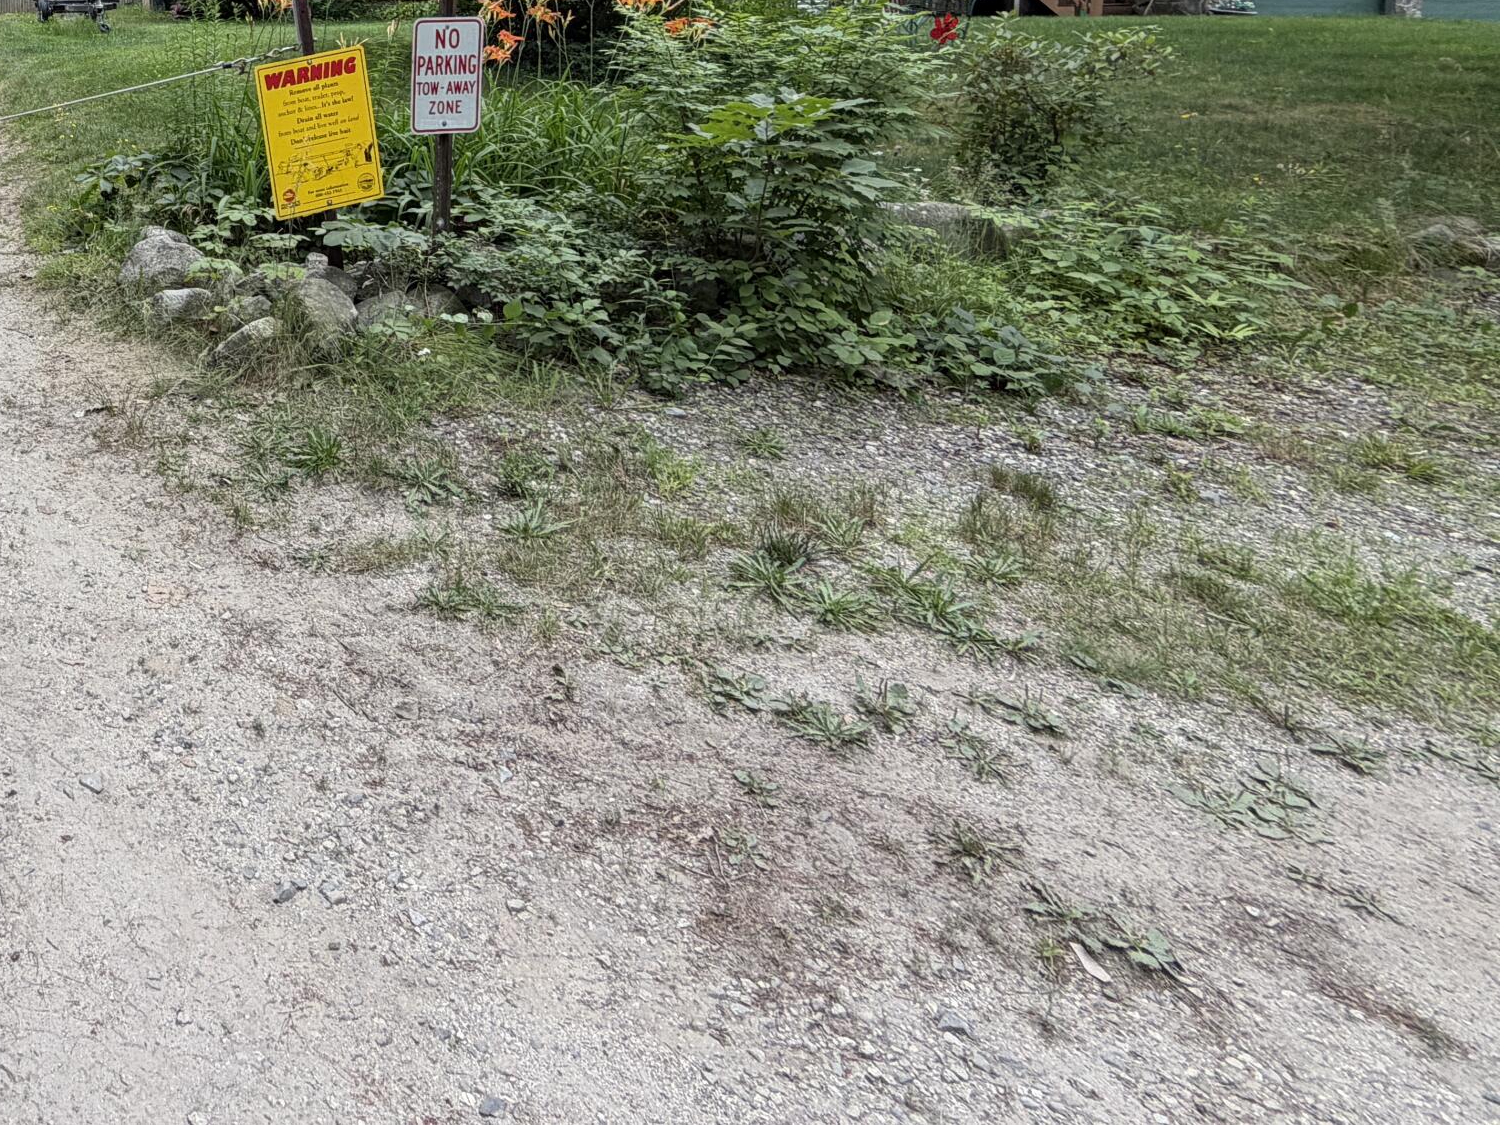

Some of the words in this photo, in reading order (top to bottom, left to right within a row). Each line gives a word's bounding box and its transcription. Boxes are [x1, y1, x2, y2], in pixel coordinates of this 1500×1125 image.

[435, 28, 460, 49] NO
[417, 54, 477, 76] PARKING
[264, 57, 357, 91] WARNING
[289, 87, 312, 96] Remove
[321, 81, 338, 90] plants
[416, 80, 477, 96] TOW-AWAY
[278, 108, 296, 117] anchor
[331, 98, 341, 106] the
[283, 99, 297, 107] from
[428, 100, 463, 115] ZONE
[296, 116, 313, 124] Drain
[323, 110, 339, 119] water
[278, 130, 292, 138] from
[306, 123, 316, 132] and
[317, 120, 327, 129] live
[290, 137, 308, 146] Don'
[328, 130, 339, 138] live
